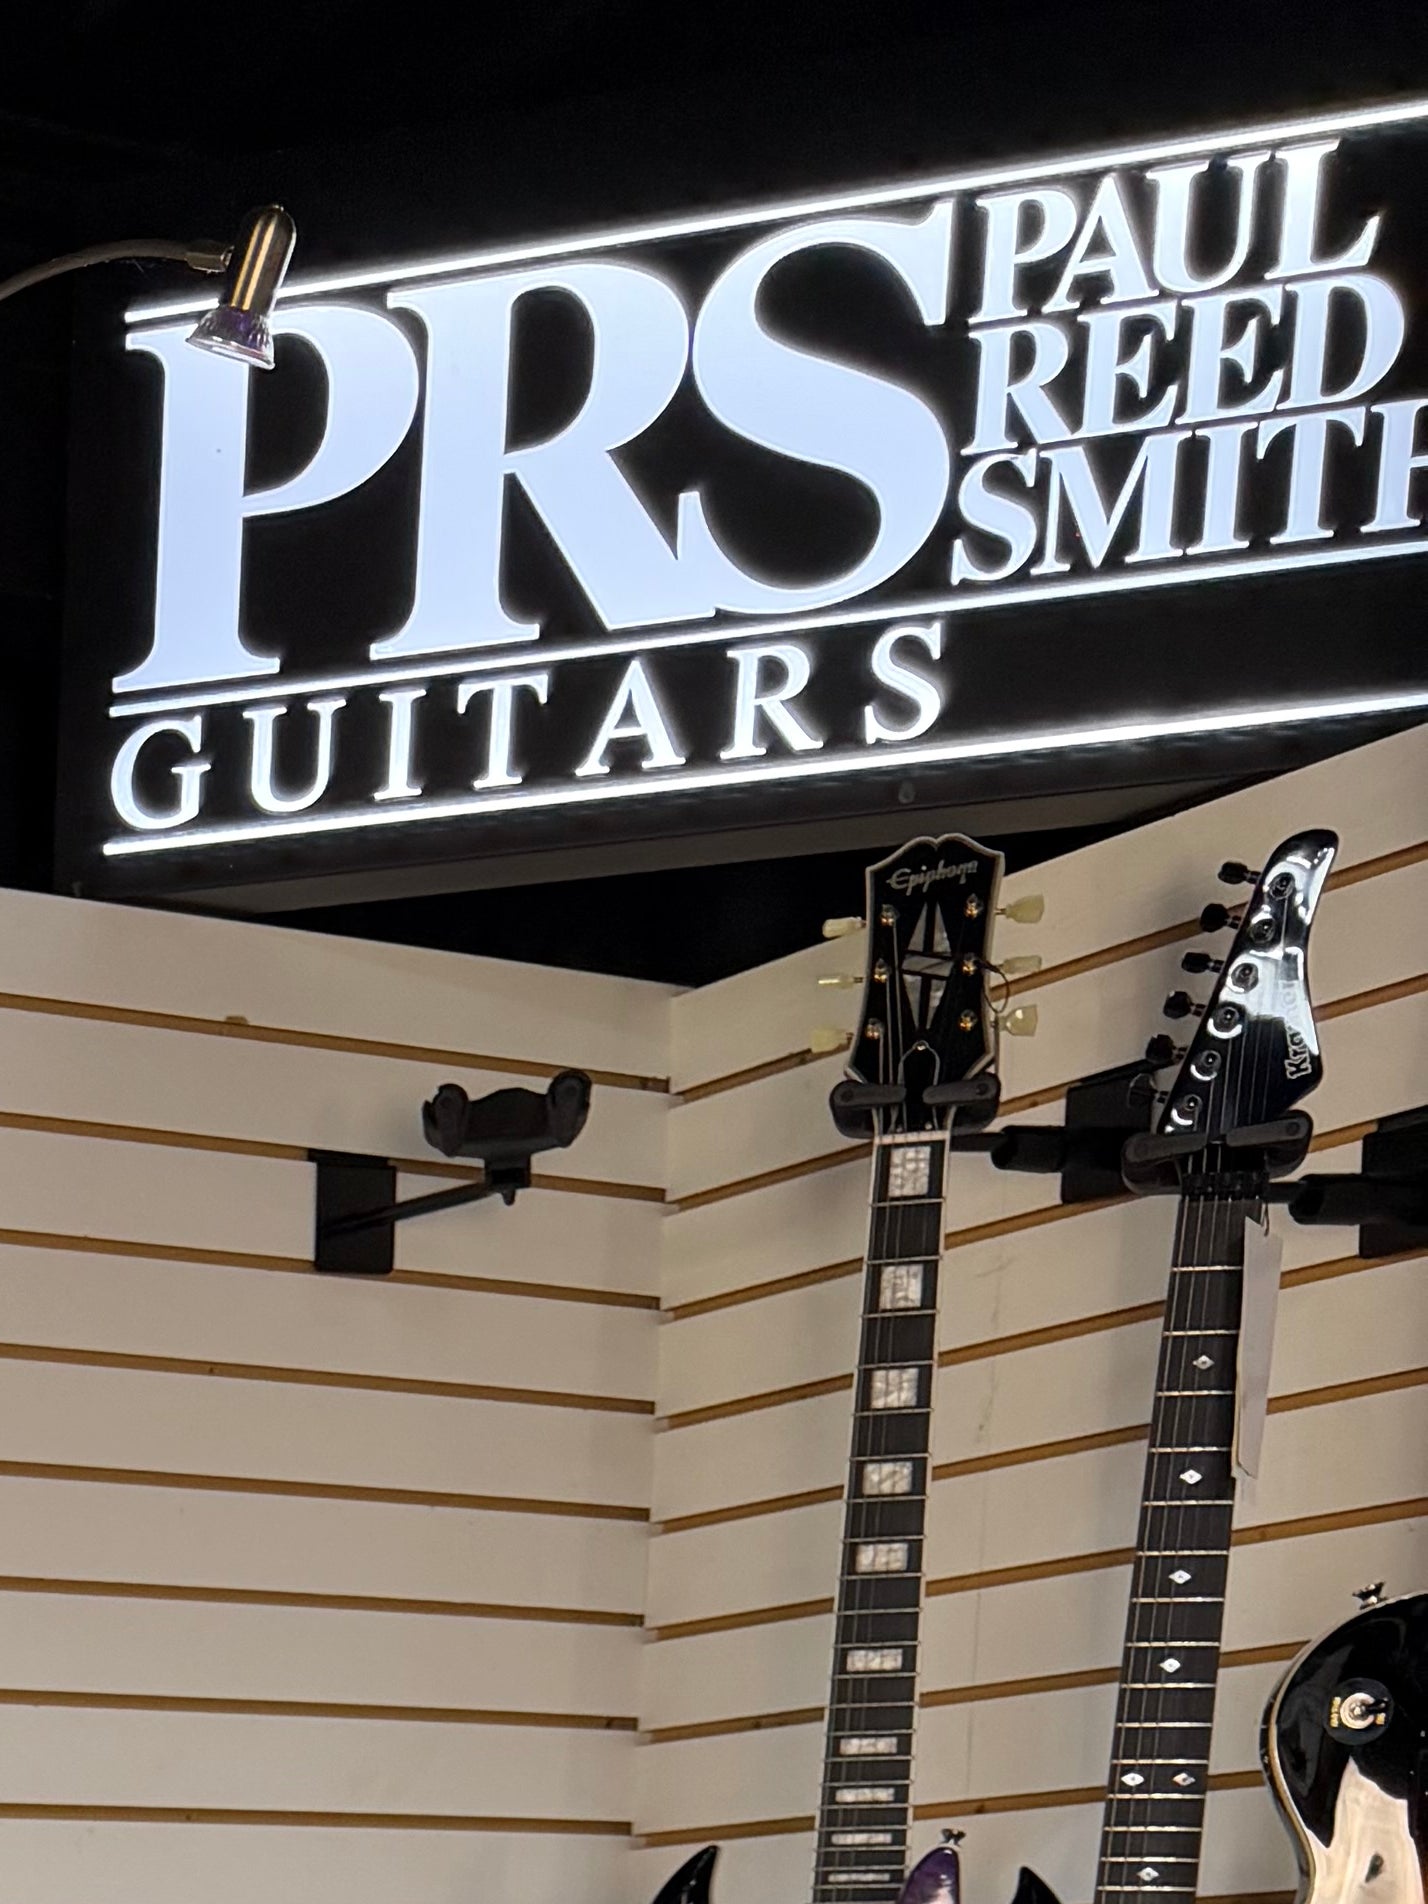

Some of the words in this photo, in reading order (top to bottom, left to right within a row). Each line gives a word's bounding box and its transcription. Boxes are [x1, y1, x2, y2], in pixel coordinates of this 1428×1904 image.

[968, 140, 1386, 323] PAUL
[110, 198, 951, 694] PRS
[961, 272, 1407, 459] REED
[110, 621, 943, 831] GUITARS
